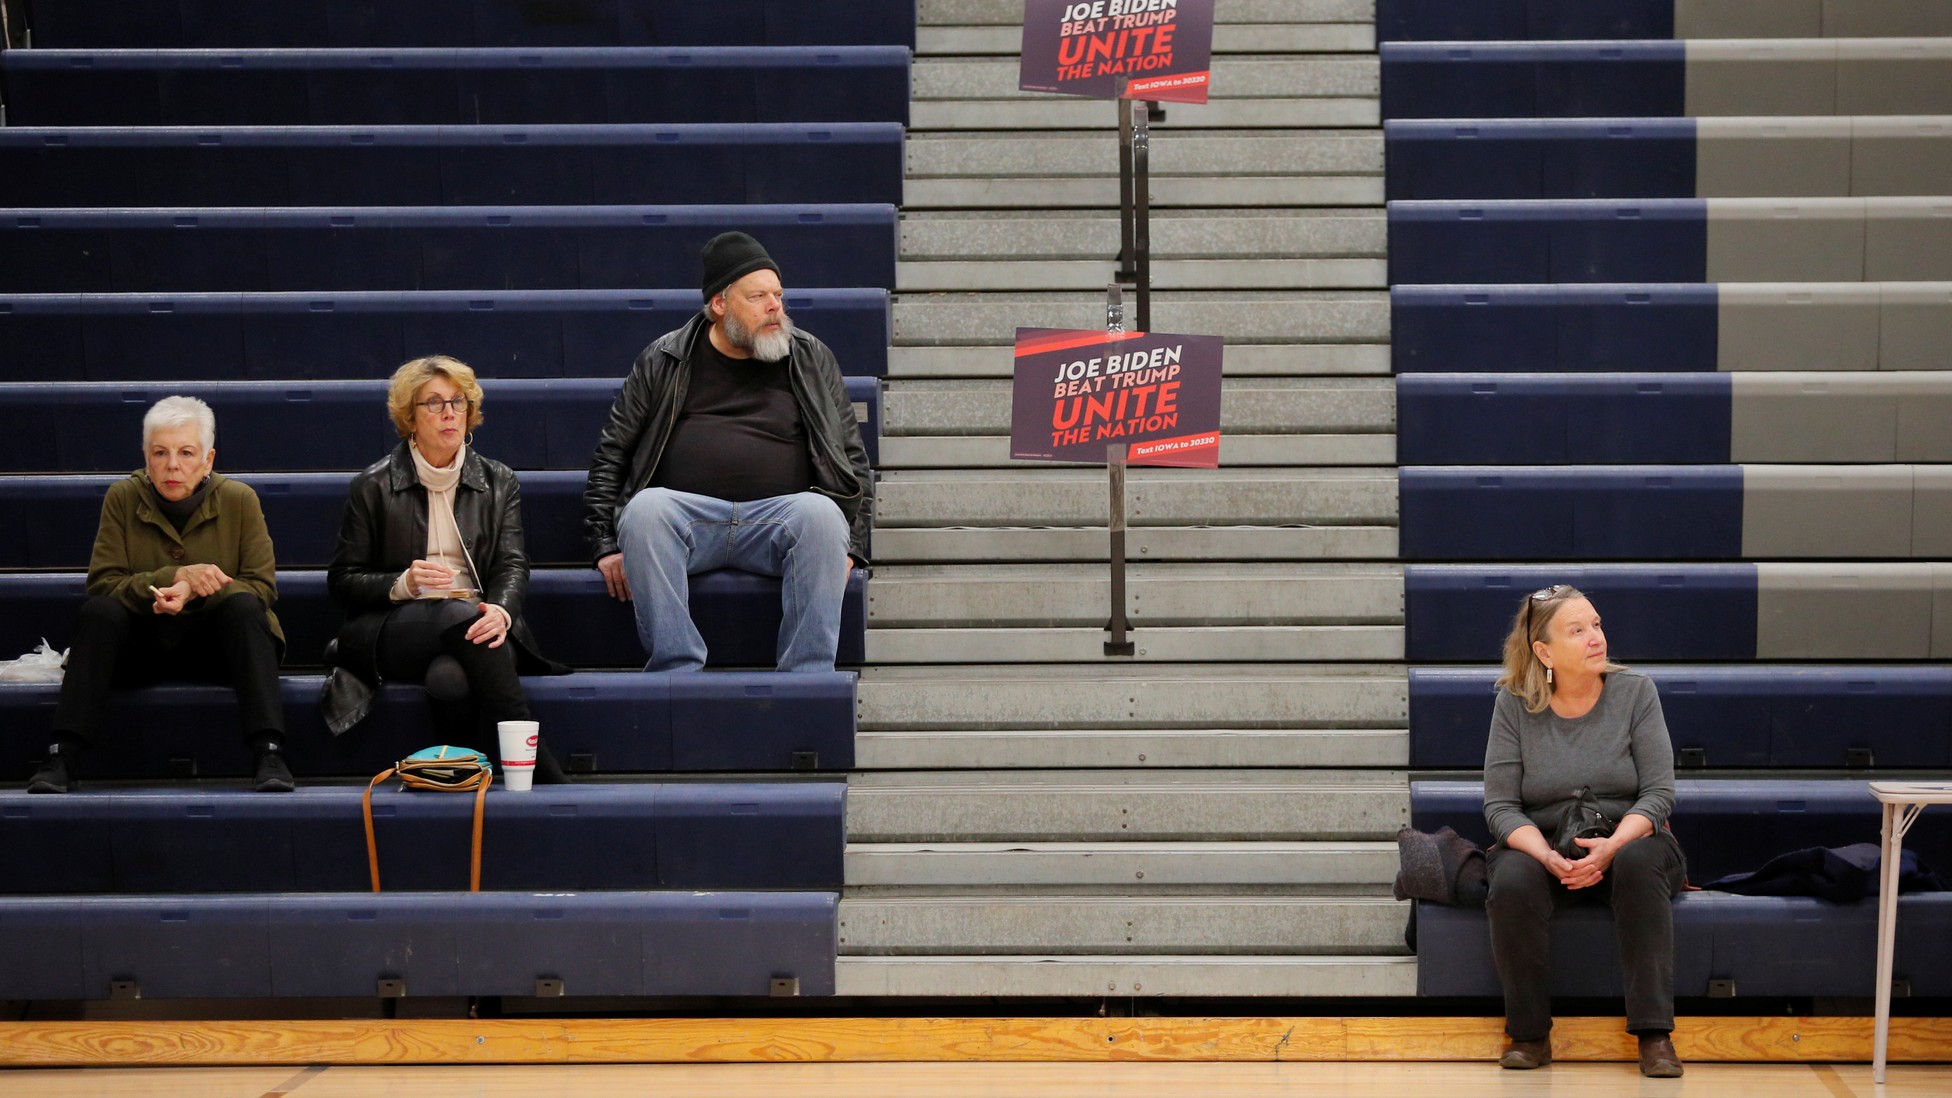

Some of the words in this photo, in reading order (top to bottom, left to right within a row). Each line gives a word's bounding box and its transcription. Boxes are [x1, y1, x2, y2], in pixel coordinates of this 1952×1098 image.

[1060, 18, 1108, 37] BEAT
[1113, 9, 1177, 30] TRUMP
[1061, 1, 1103, 23] JOE
[1107, 0, 1177, 16] BIDEN
[1057, 24, 1176, 66] UNITE
[1056, 62, 1094, 81] THE
[1097, 53, 1173, 76] NATION
[1134, 82, 1149, 90] Text
[1150, 80, 1172, 88] IOWA
[1054, 357, 1102, 383] JOE
[1106, 344, 1183, 374] BIDEN
[1053, 376, 1107, 398] BEAT
[1112, 364, 1181, 389] TRUMP
[1051, 381, 1181, 430] UNITE
[1051, 425, 1092, 447] THE
[1096, 412, 1179, 440] NATION
[1136, 447, 1154, 455] Text
[1154, 442, 1179, 452] IOWA
[1189, 436, 1215, 447] 30330
